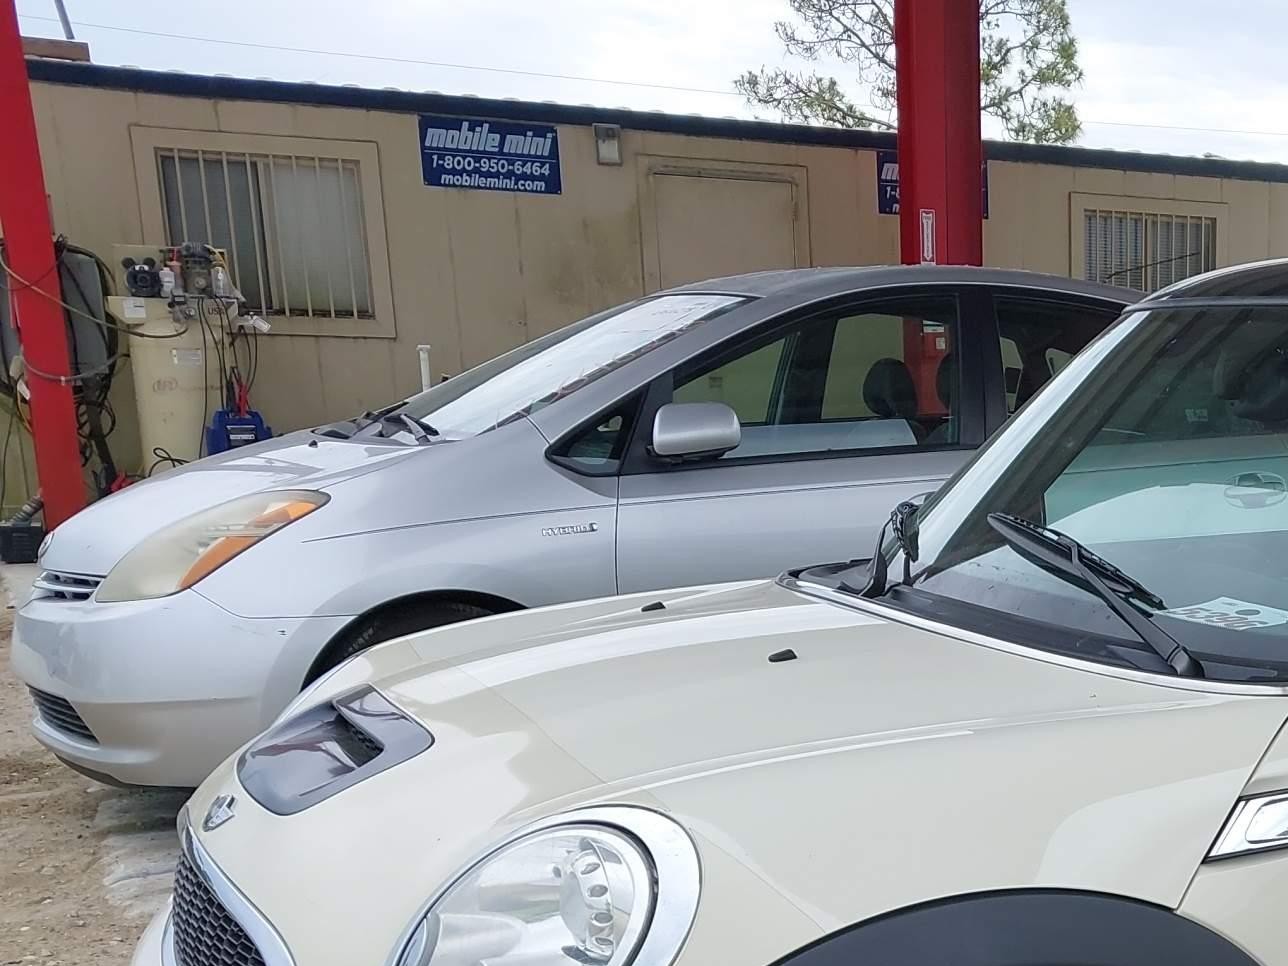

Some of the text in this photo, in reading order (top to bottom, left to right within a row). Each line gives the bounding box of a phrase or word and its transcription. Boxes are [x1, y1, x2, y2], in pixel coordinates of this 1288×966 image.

[424, 121, 552, 156] mobile mini
[431, 154, 550, 176] 1-800-950-6464
[440, 173, 546, 191] mobilemini.com
